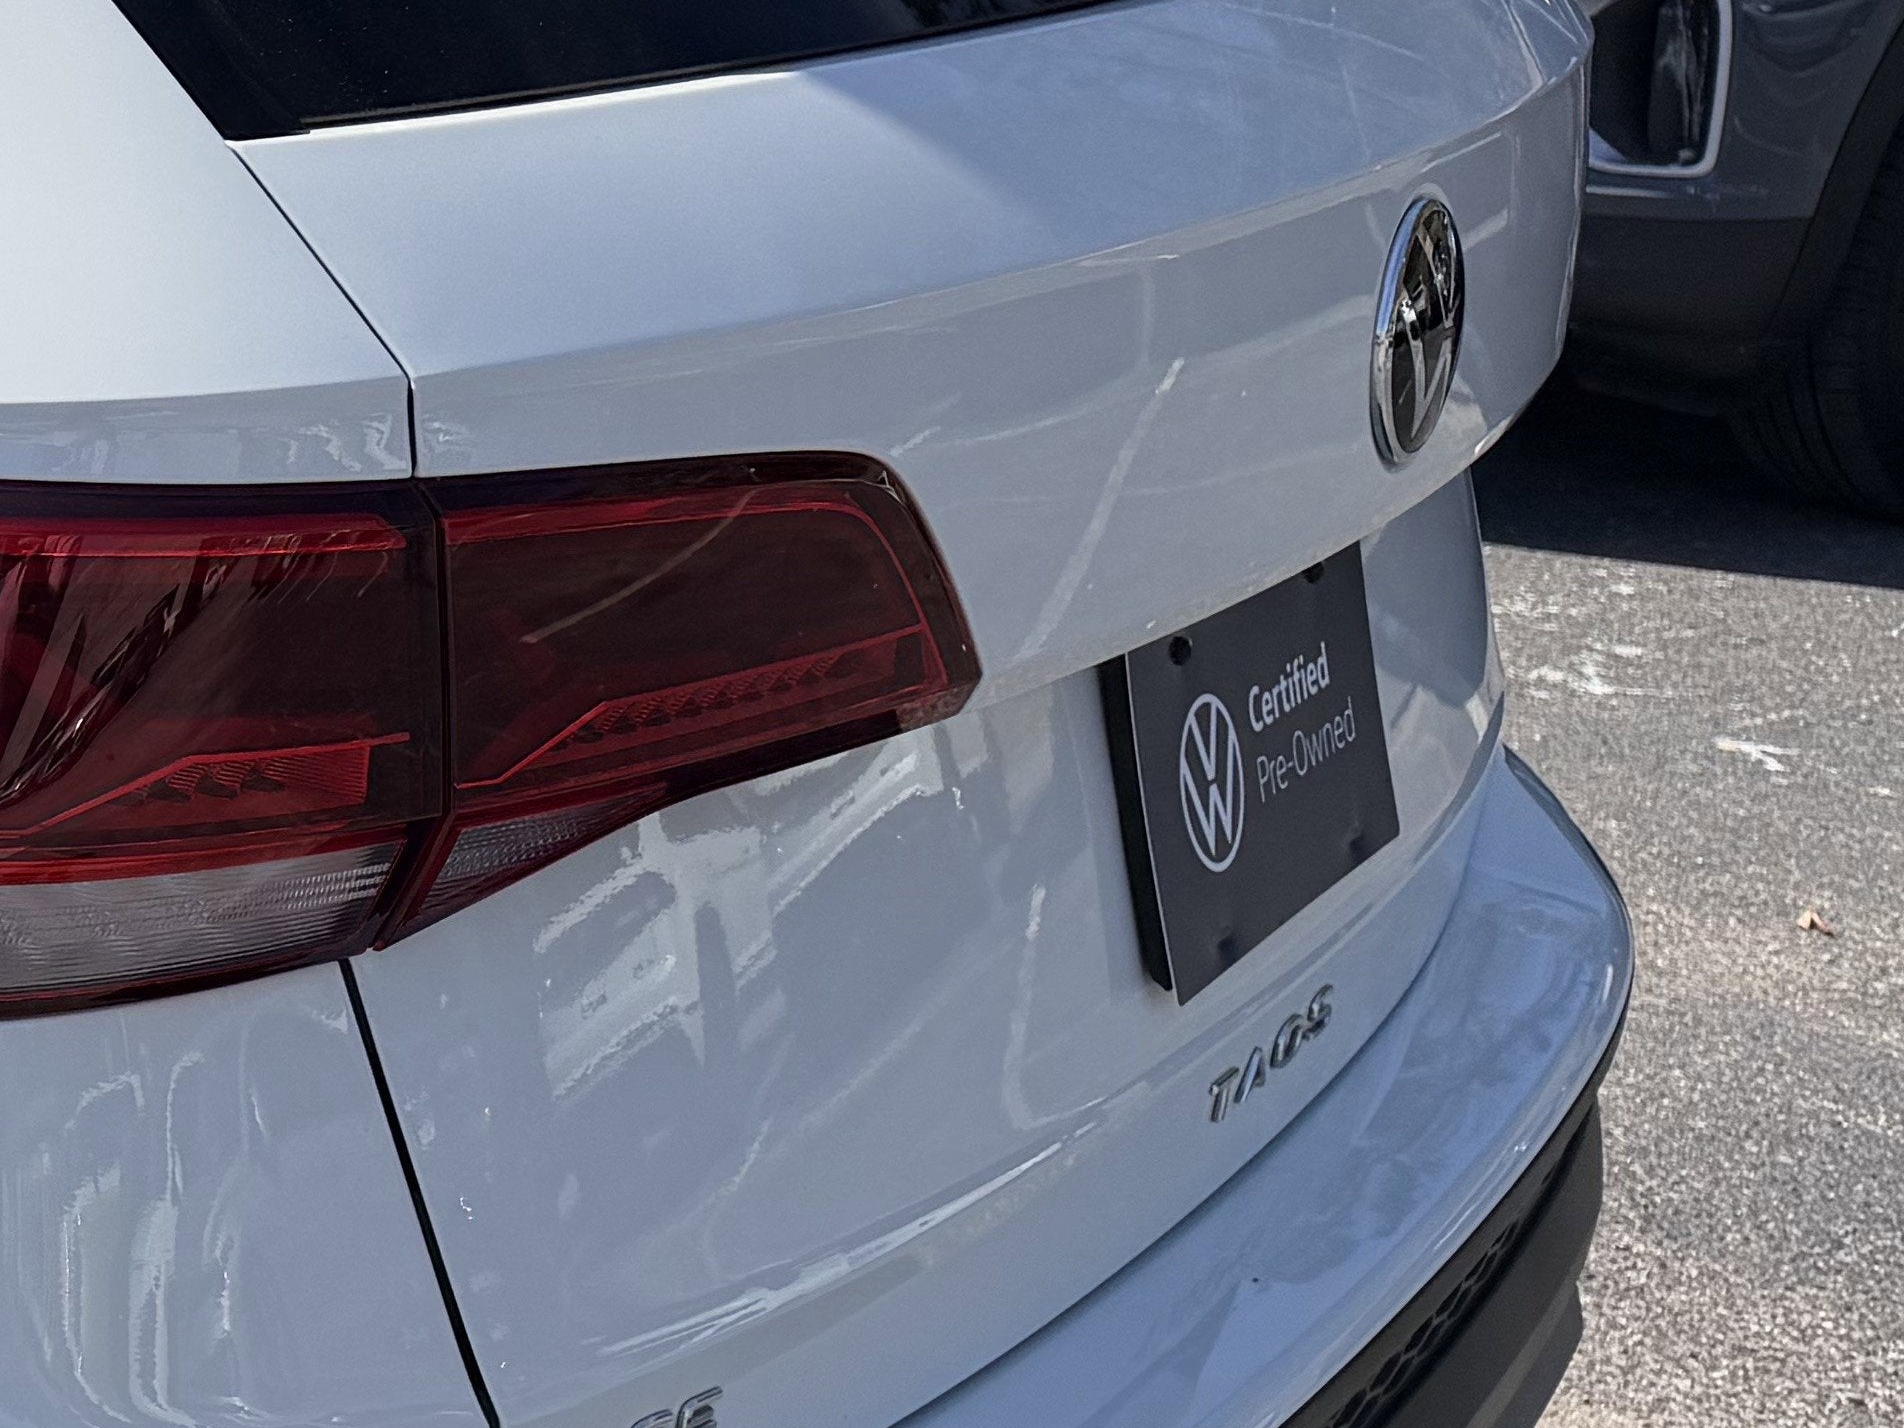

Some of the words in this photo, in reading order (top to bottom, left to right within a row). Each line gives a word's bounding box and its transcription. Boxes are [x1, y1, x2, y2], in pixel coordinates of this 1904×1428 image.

[1248, 640, 1331, 733] Certified
[1255, 696, 1357, 804] Pre-Owned
[1208, 983, 1334, 1123] TAOS
